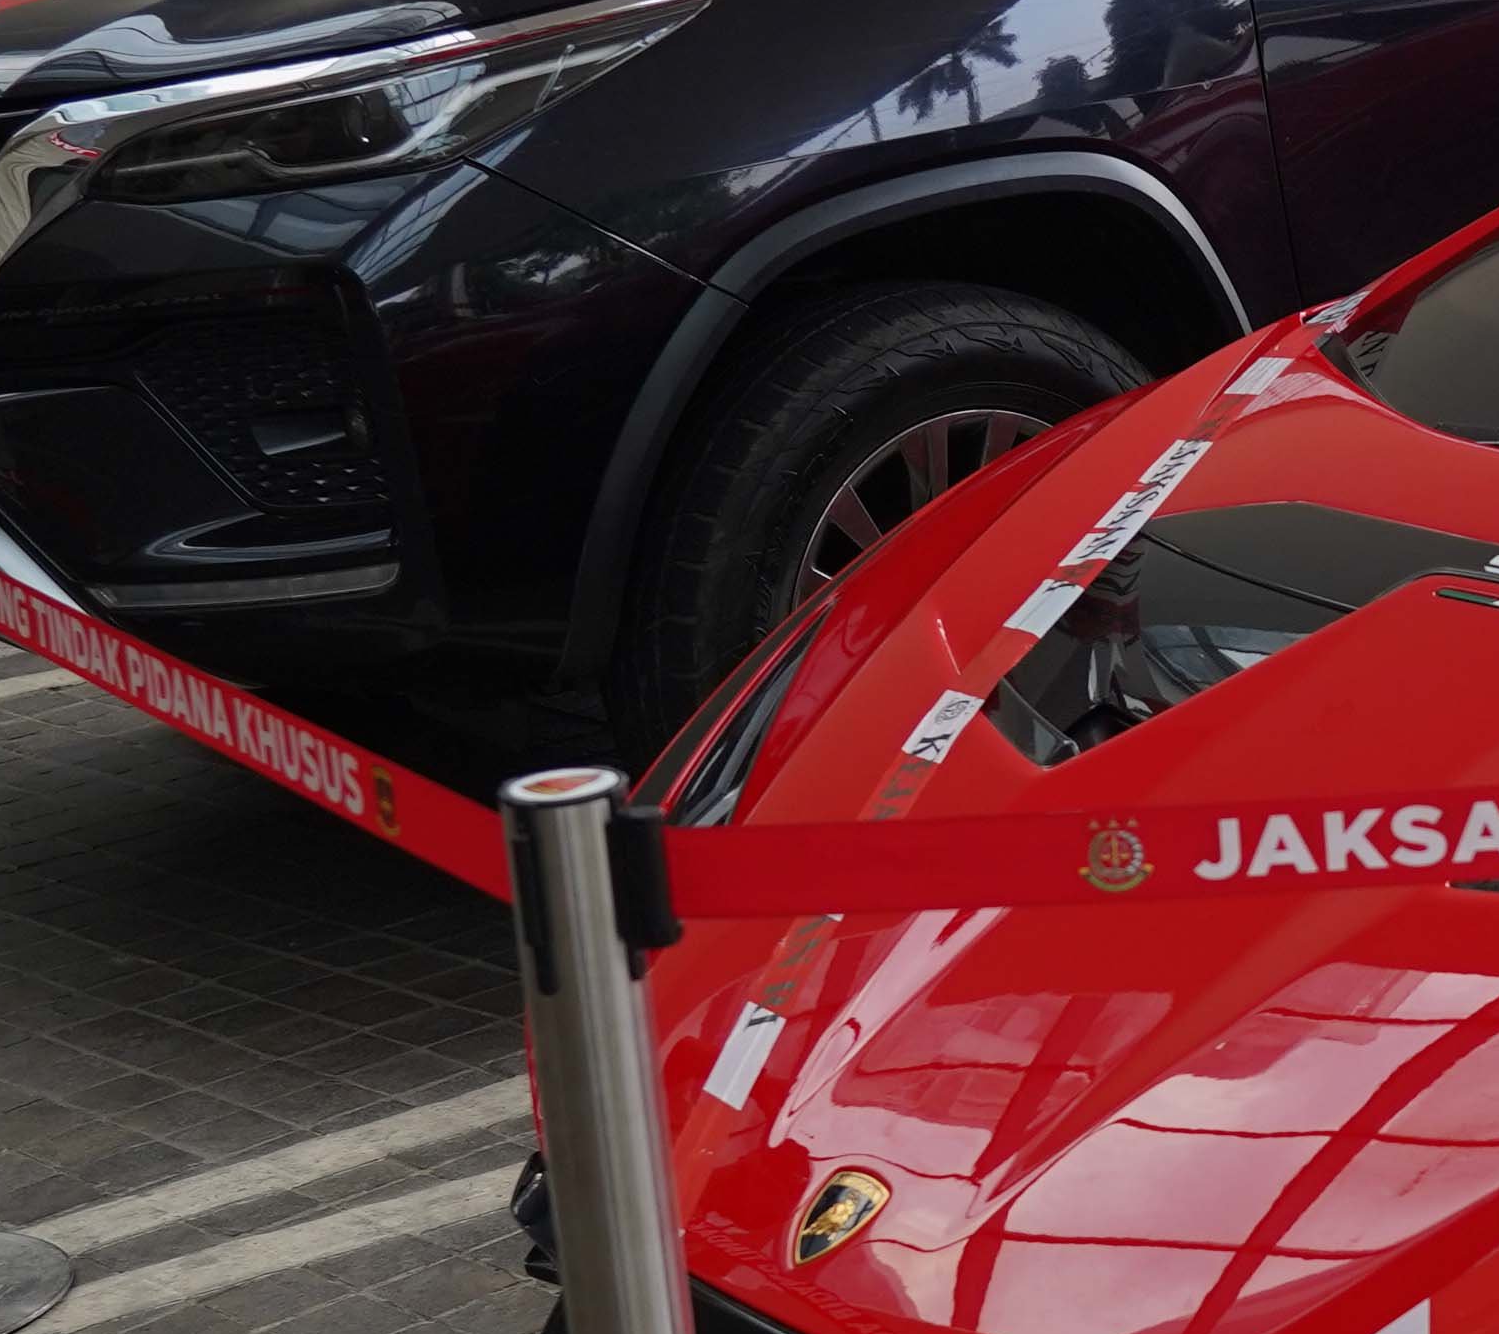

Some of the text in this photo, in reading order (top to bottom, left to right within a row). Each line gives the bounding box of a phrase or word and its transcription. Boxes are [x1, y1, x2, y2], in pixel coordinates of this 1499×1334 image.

[29, 594, 128, 693] TINDAK
[124, 645, 234, 742] PIDANA
[235, 695, 366, 817] KHUSUS
